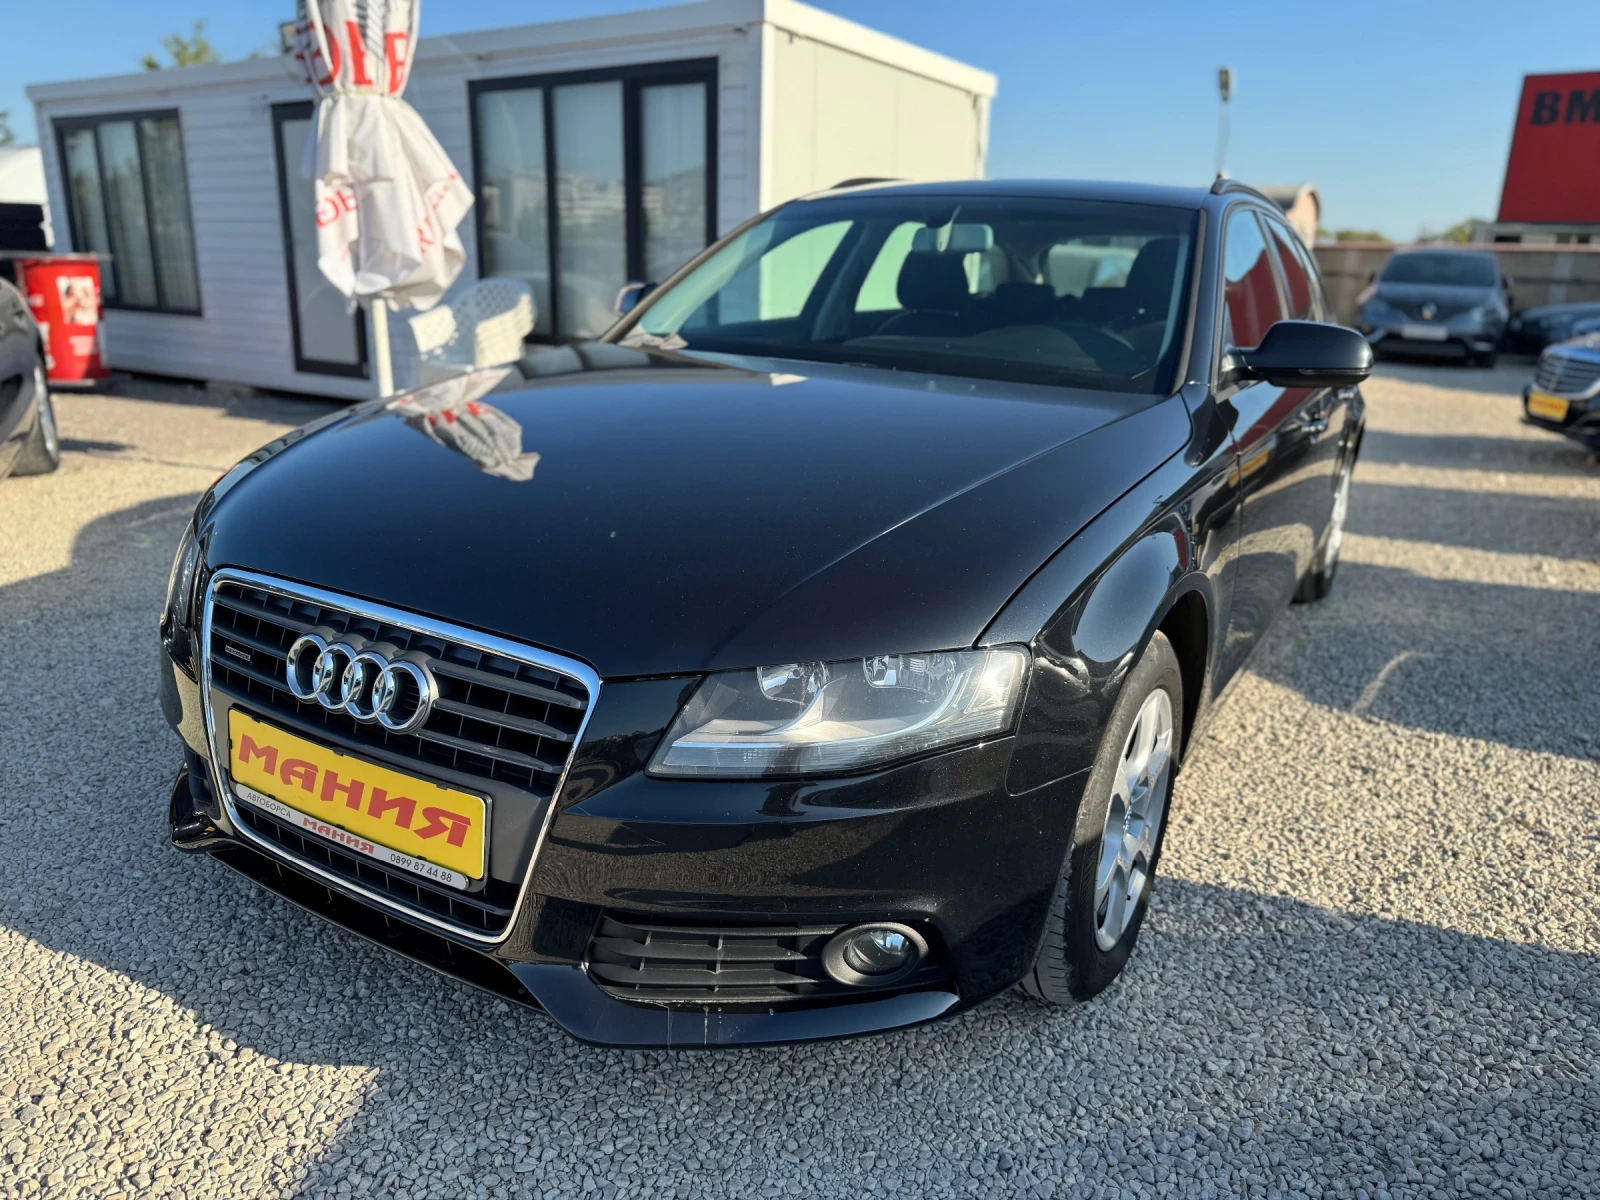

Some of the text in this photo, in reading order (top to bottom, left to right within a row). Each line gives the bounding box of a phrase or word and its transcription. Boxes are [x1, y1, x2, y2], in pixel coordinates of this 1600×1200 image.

[238, 733, 471, 848] МАНИЯ
[246, 792, 452, 883] АВТОБОРСА МАНИЯ 0899 87 44 88
